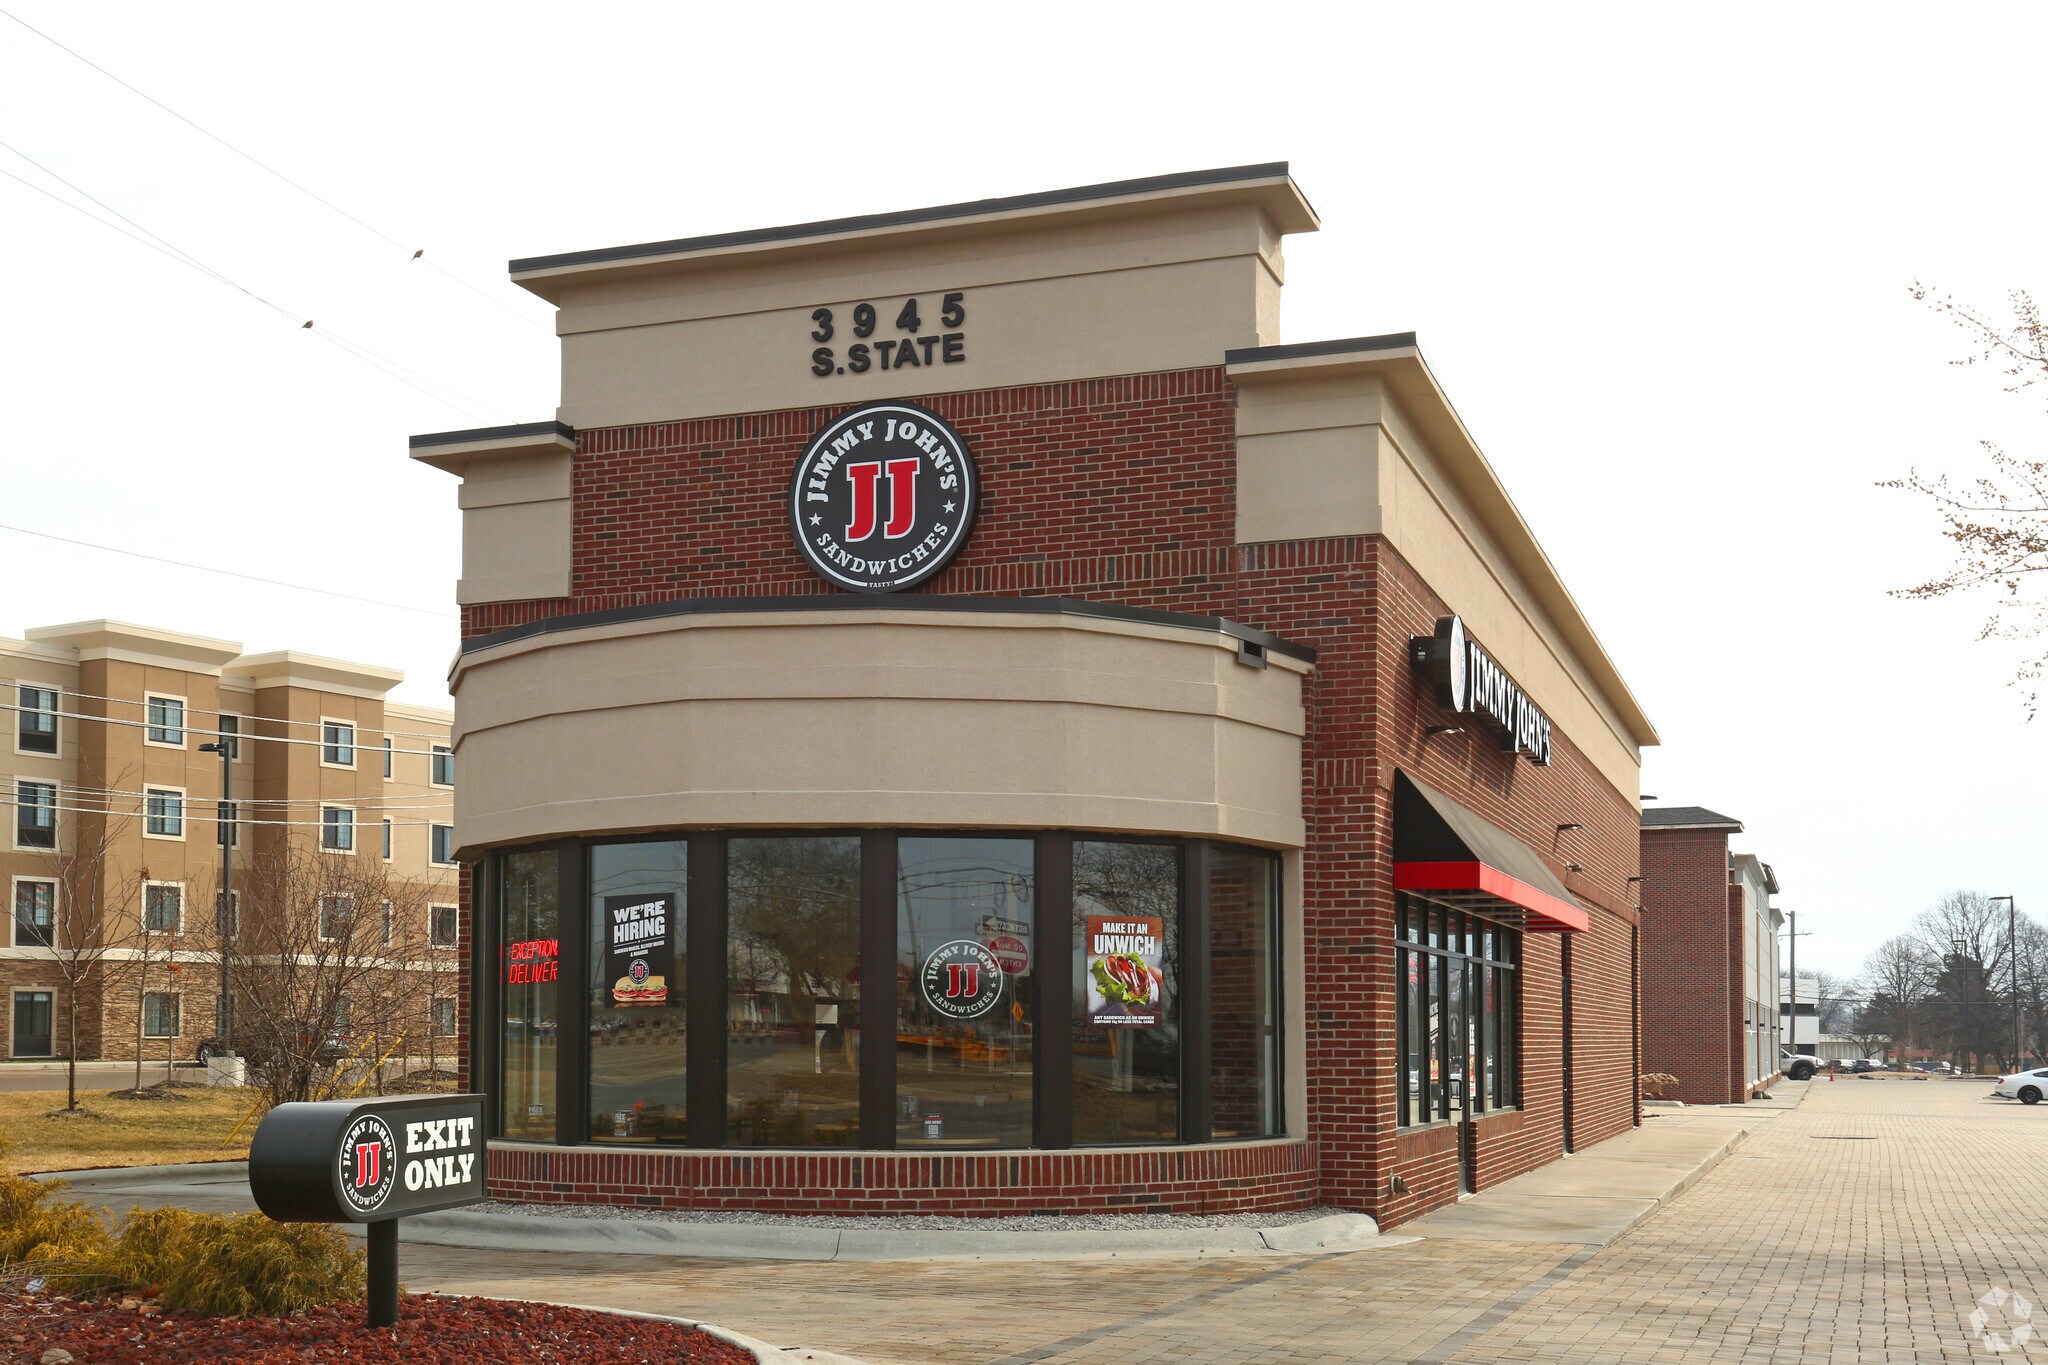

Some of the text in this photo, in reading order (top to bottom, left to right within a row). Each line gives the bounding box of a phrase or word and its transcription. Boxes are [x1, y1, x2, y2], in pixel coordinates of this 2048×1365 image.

[807, 418, 957, 502] JIMMY JOHN'S
[845, 457, 920, 542] JJ
[816, 521, 948, 575] SANDWICHES
[869, 580, 894, 588] TASTY!
[1470, 641, 1551, 767] JIMMY JOHN'S
[613, 899, 665, 924] WE'RE
[1102, 922, 1148, 934] MAKE IT AN
[613, 916, 665, 944] HIRING
[1094, 934, 1155, 955] UNWICH
[927, 945, 998, 980] JIMMY JOHN'S
[946, 963, 980, 998] JJ
[933, 991, 994, 1014] SANDWICHES
[343, 1120, 393, 1166] JIMMY JOHN'S
[406, 1117, 474, 1153] EXIT
[356, 1141, 381, 1188] JJ
[404, 1153, 475, 1191] ONLY
[346, 1176, 390, 1206] SANDWICHES
